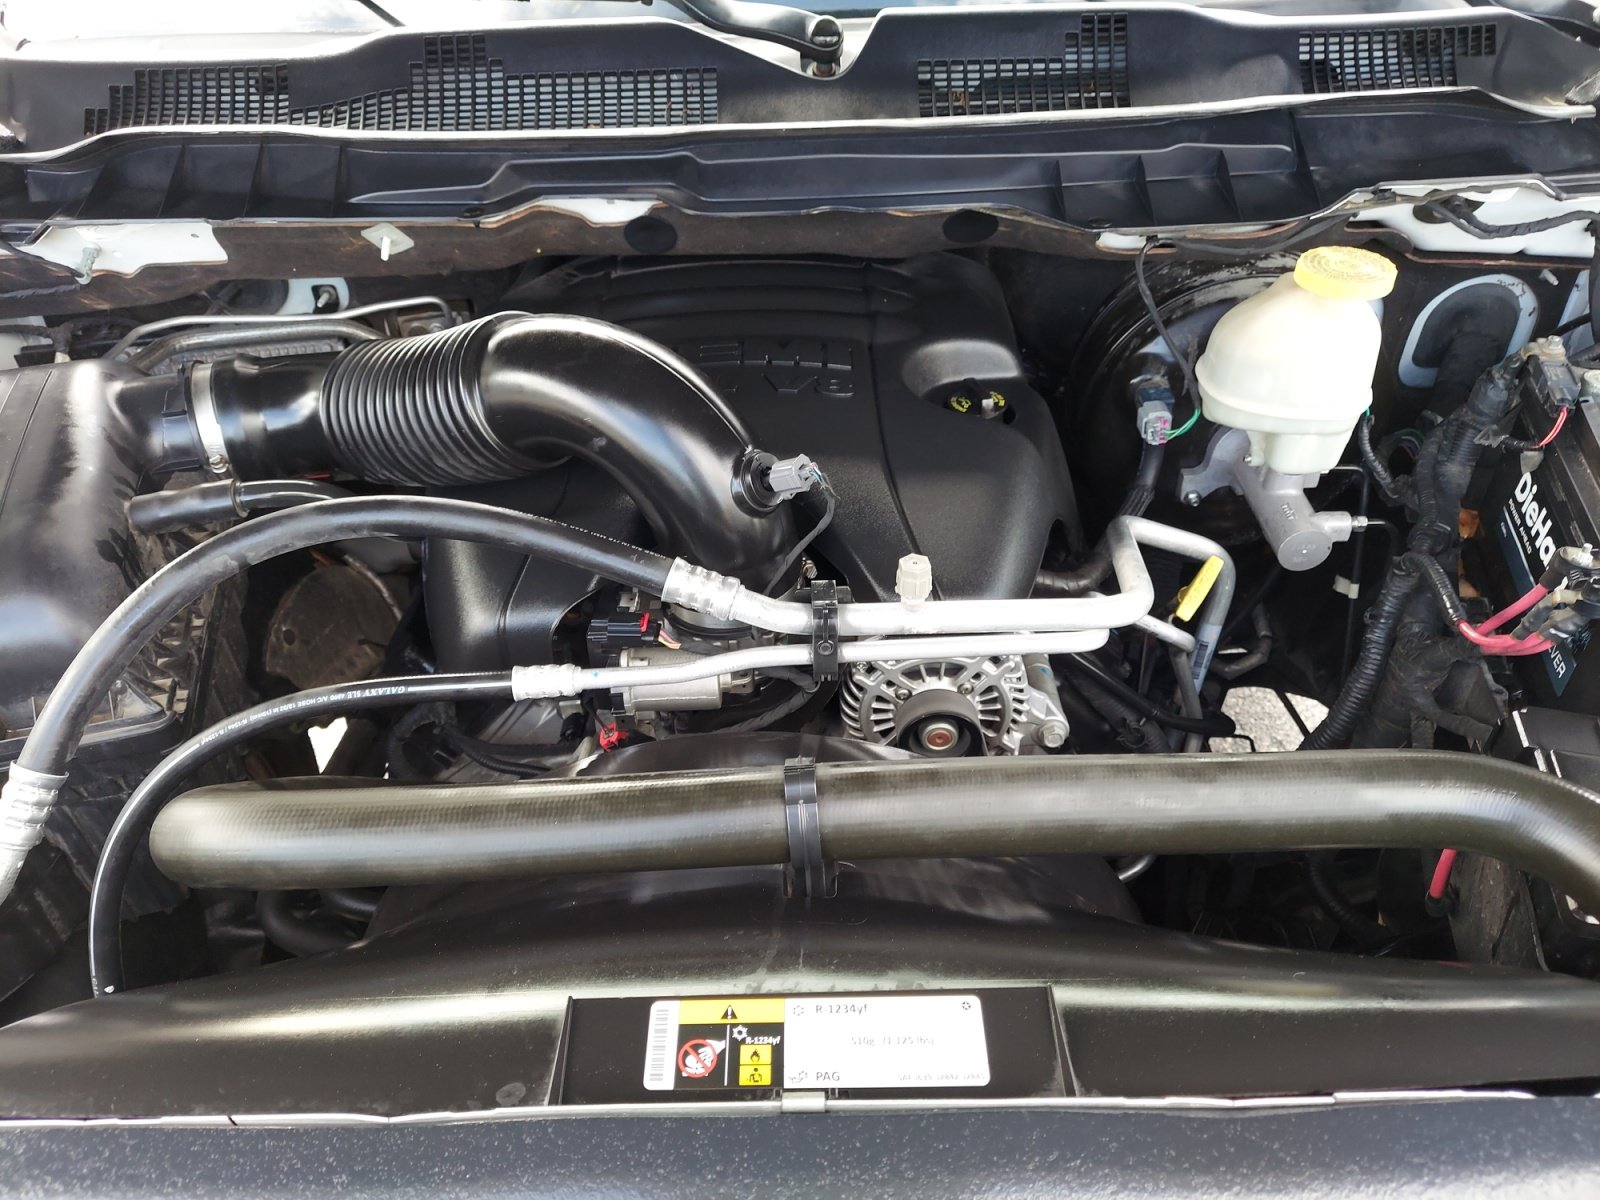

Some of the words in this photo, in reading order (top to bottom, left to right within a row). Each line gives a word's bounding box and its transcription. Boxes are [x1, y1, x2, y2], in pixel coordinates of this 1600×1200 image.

[1508, 498, 1521, 526] POWER
[1519, 524, 1532, 555] AHEAD
[1514, 471, 1562, 576] DieHa
[346, 690, 361, 699] SLE
[363, 686, 405, 697] GALAXY
[297, 698, 316, 707] HOSE
[316, 695, 328, 704] A/C
[815, 1003, 869, 1016] R-1234yf
[746, 1035, 781, 1045] R-1234yf
[815, 1071, 841, 1081] PAG
